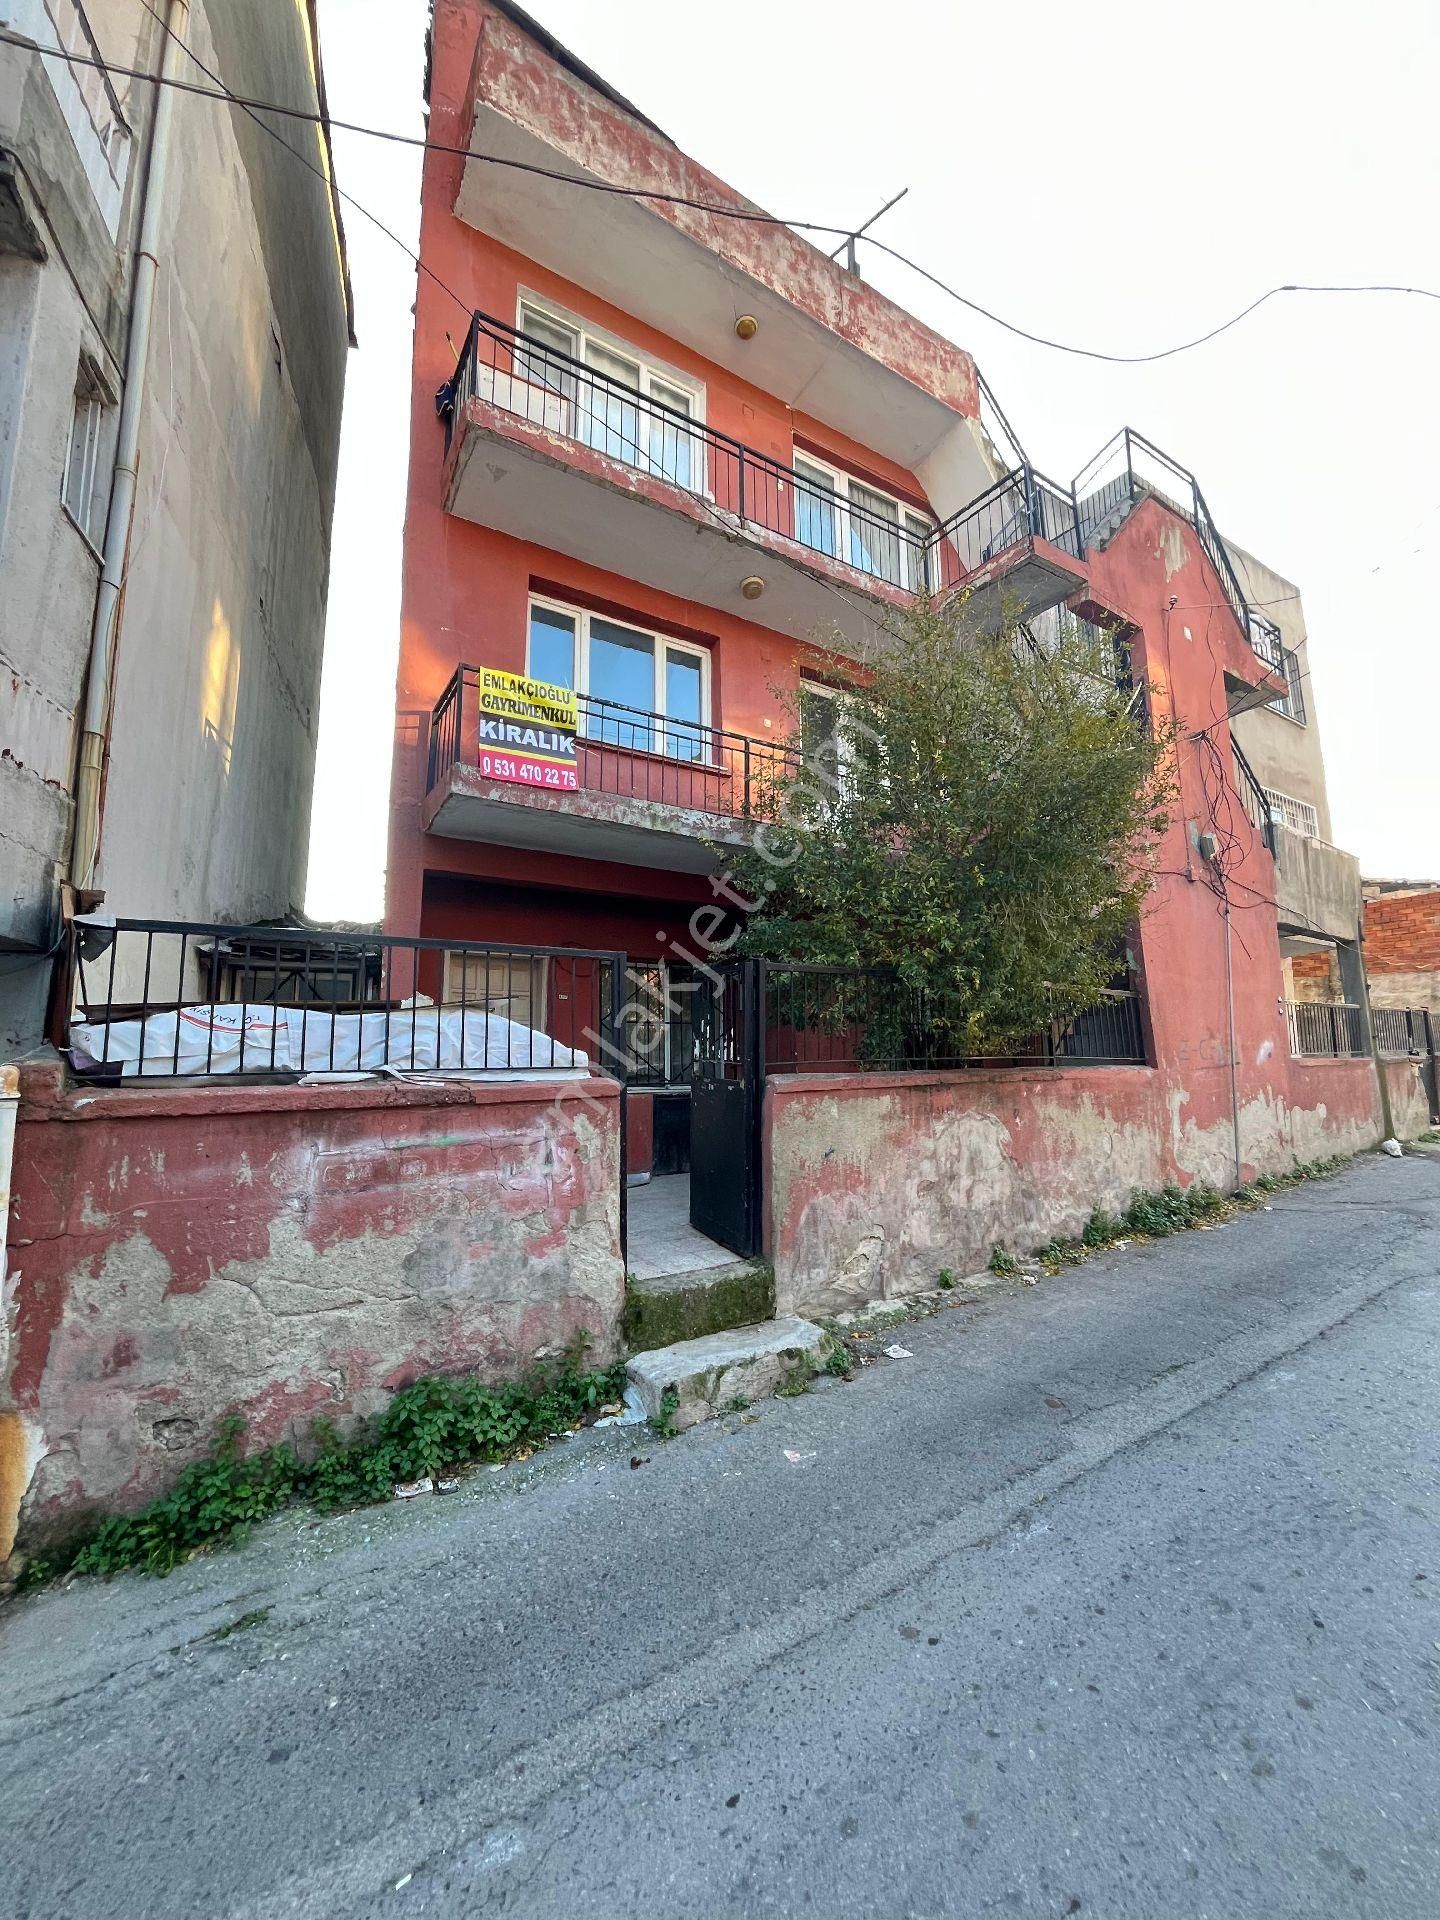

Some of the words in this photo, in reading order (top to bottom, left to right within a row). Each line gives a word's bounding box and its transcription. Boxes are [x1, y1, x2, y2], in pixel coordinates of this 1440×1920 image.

[484, 672, 570, 704] EMLAKÇIOĞLU
[481, 692, 576, 725] GAYRİMENKUL
[480, 719, 576, 754] KİRALIK
[483, 757, 491, 773] 0
[494, 759, 516, 777] 531
[519, 764, 542, 782] 470
[545, 768, 560, 785] 22
[561, 770, 577, 787] 75
